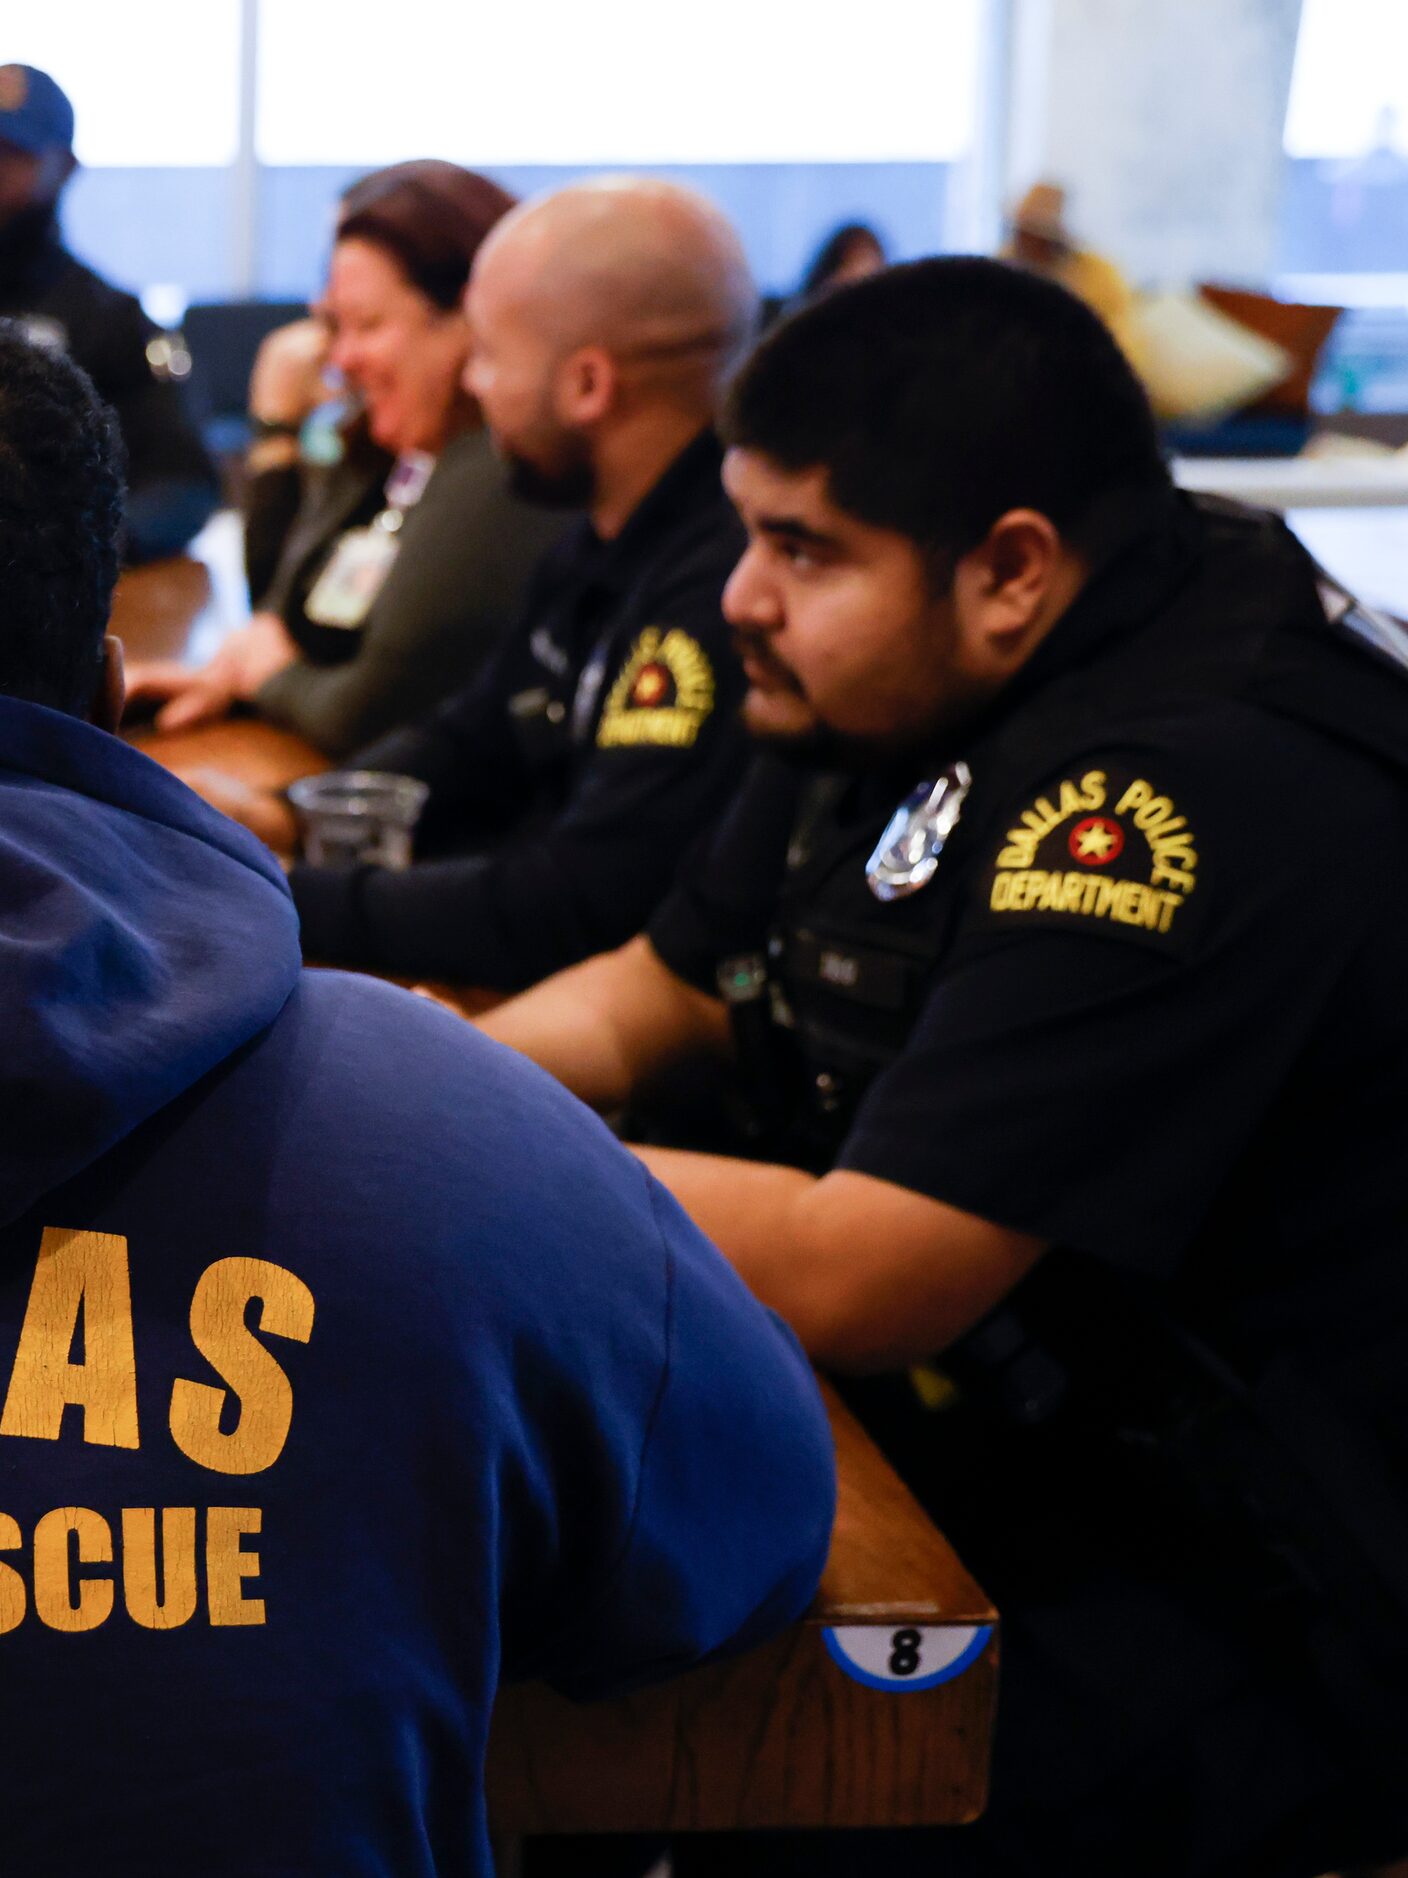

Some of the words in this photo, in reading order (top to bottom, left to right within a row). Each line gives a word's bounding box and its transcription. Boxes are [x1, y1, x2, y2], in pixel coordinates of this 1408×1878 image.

[995, 769, 1107, 870] DALLAS
[1114, 778, 1199, 894] POLICE
[989, 869, 1185, 934] DEPARTMENT
[890, 1629, 921, 1676] 8
